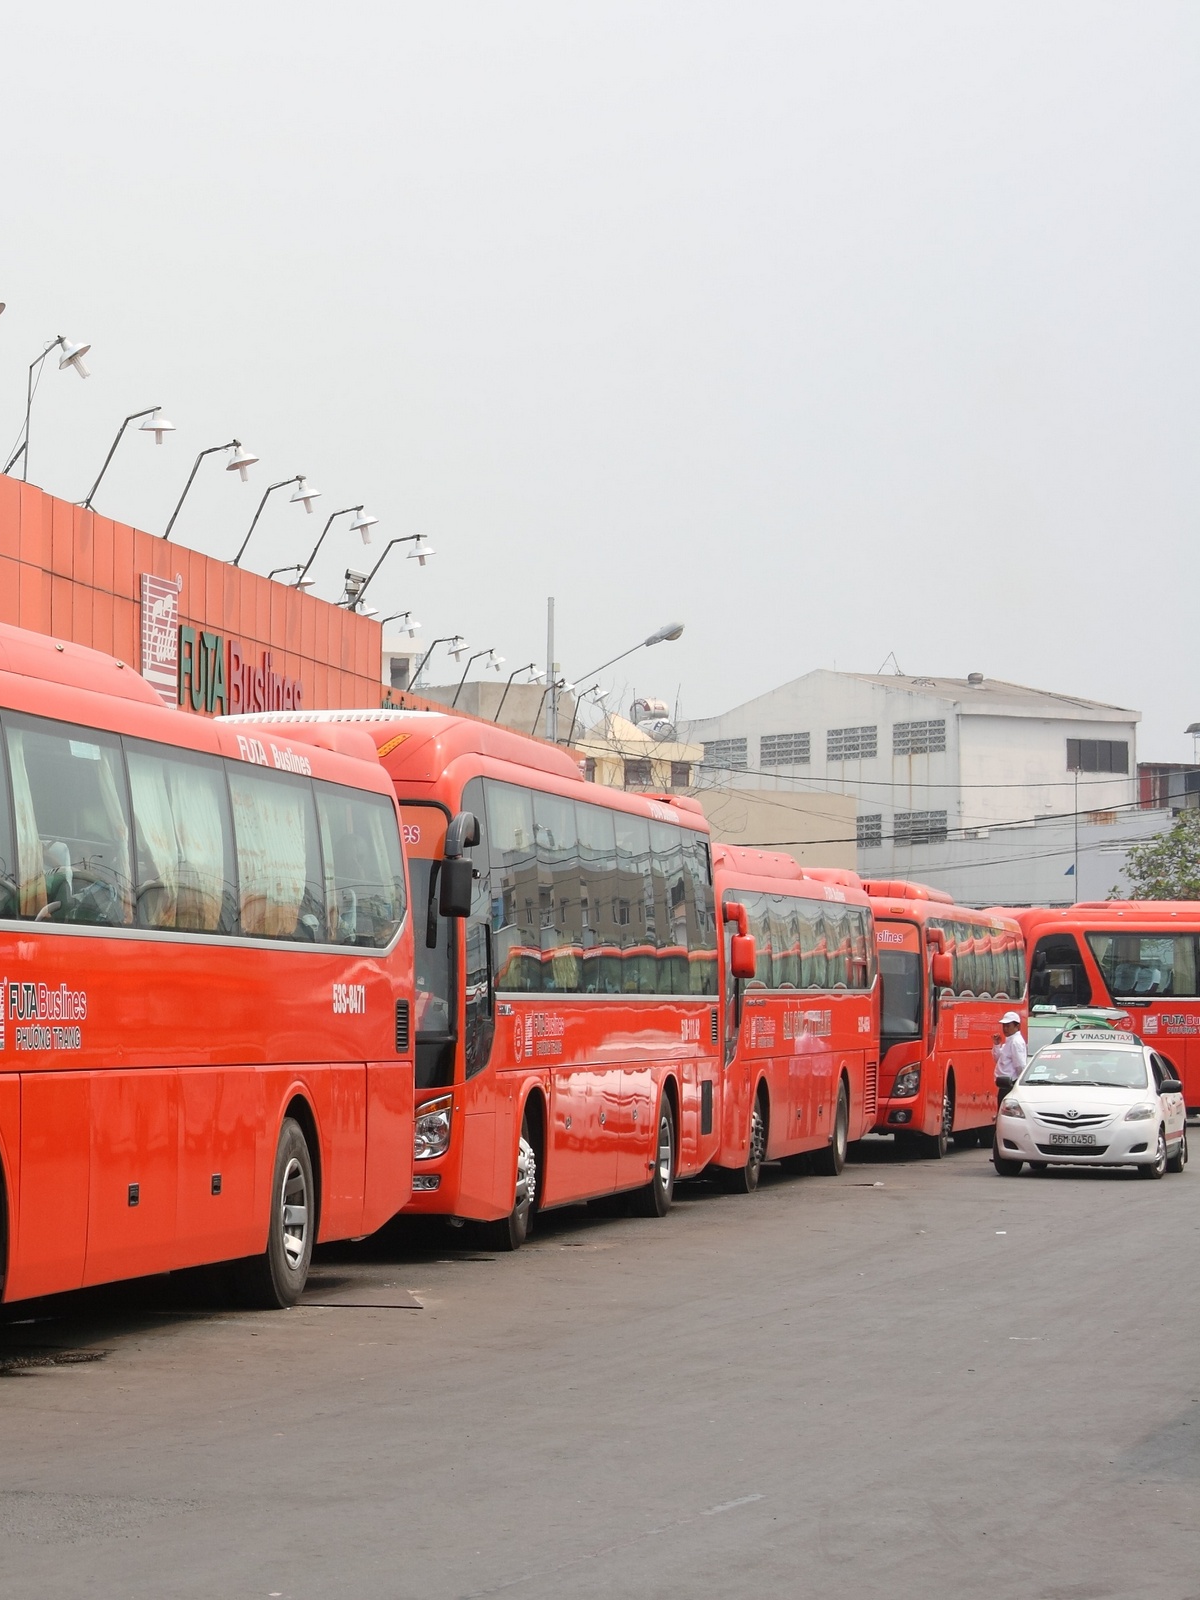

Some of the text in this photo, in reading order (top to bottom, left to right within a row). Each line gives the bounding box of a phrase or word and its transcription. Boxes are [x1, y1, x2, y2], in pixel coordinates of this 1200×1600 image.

[179, 625, 227, 715] FUTA
[227, 640, 303, 716] Buslines
[236, 735, 312, 776] FUTA Buslines
[9, 983, 39, 1020] FUTA
[39, 983, 87, 1020] Buslines
[332, 983, 366, 1014] 53S-8471
[15, 1024, 81, 1050] PHƯƠNG TRANG
[1161, 1014, 1185, 1026] FUTA
